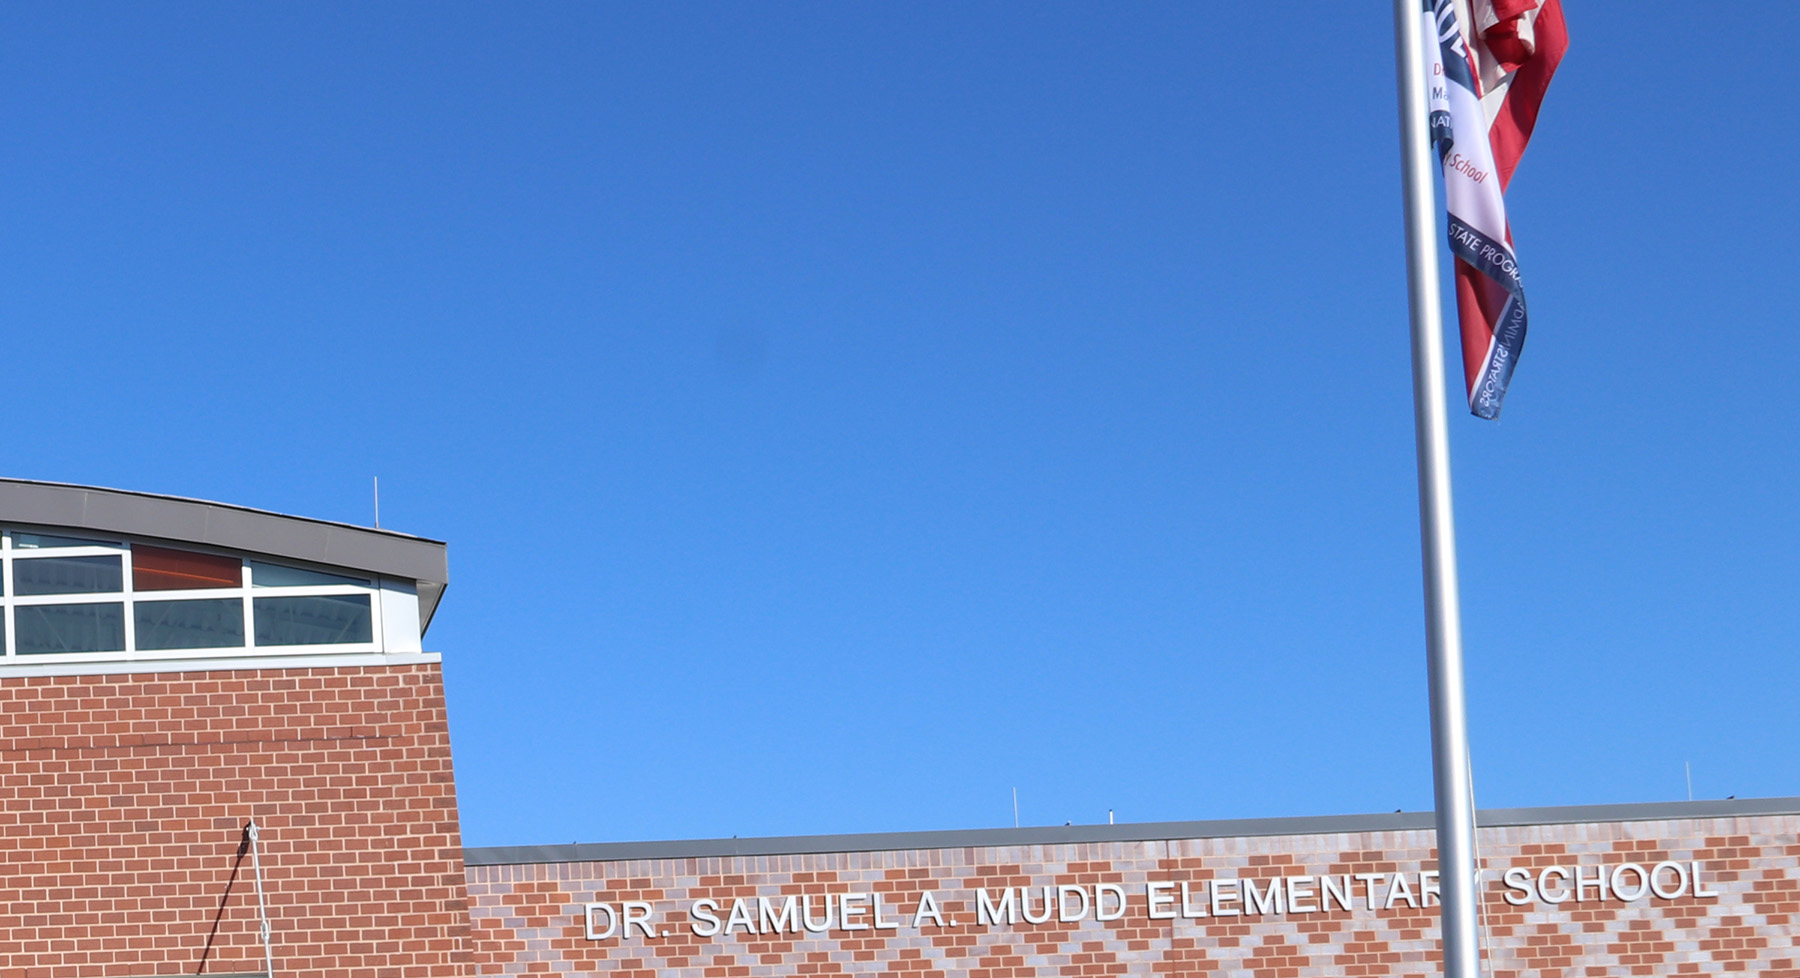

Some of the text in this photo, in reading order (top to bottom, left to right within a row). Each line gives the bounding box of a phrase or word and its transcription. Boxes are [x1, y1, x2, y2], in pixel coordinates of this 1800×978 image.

[1449, 153, 1489, 184] School
[1448, 223, 1482, 251] STATE
[584, 860, 1719, 940] DR. SAMUEL A. MUDD ELEMENTAR SCHOOL
